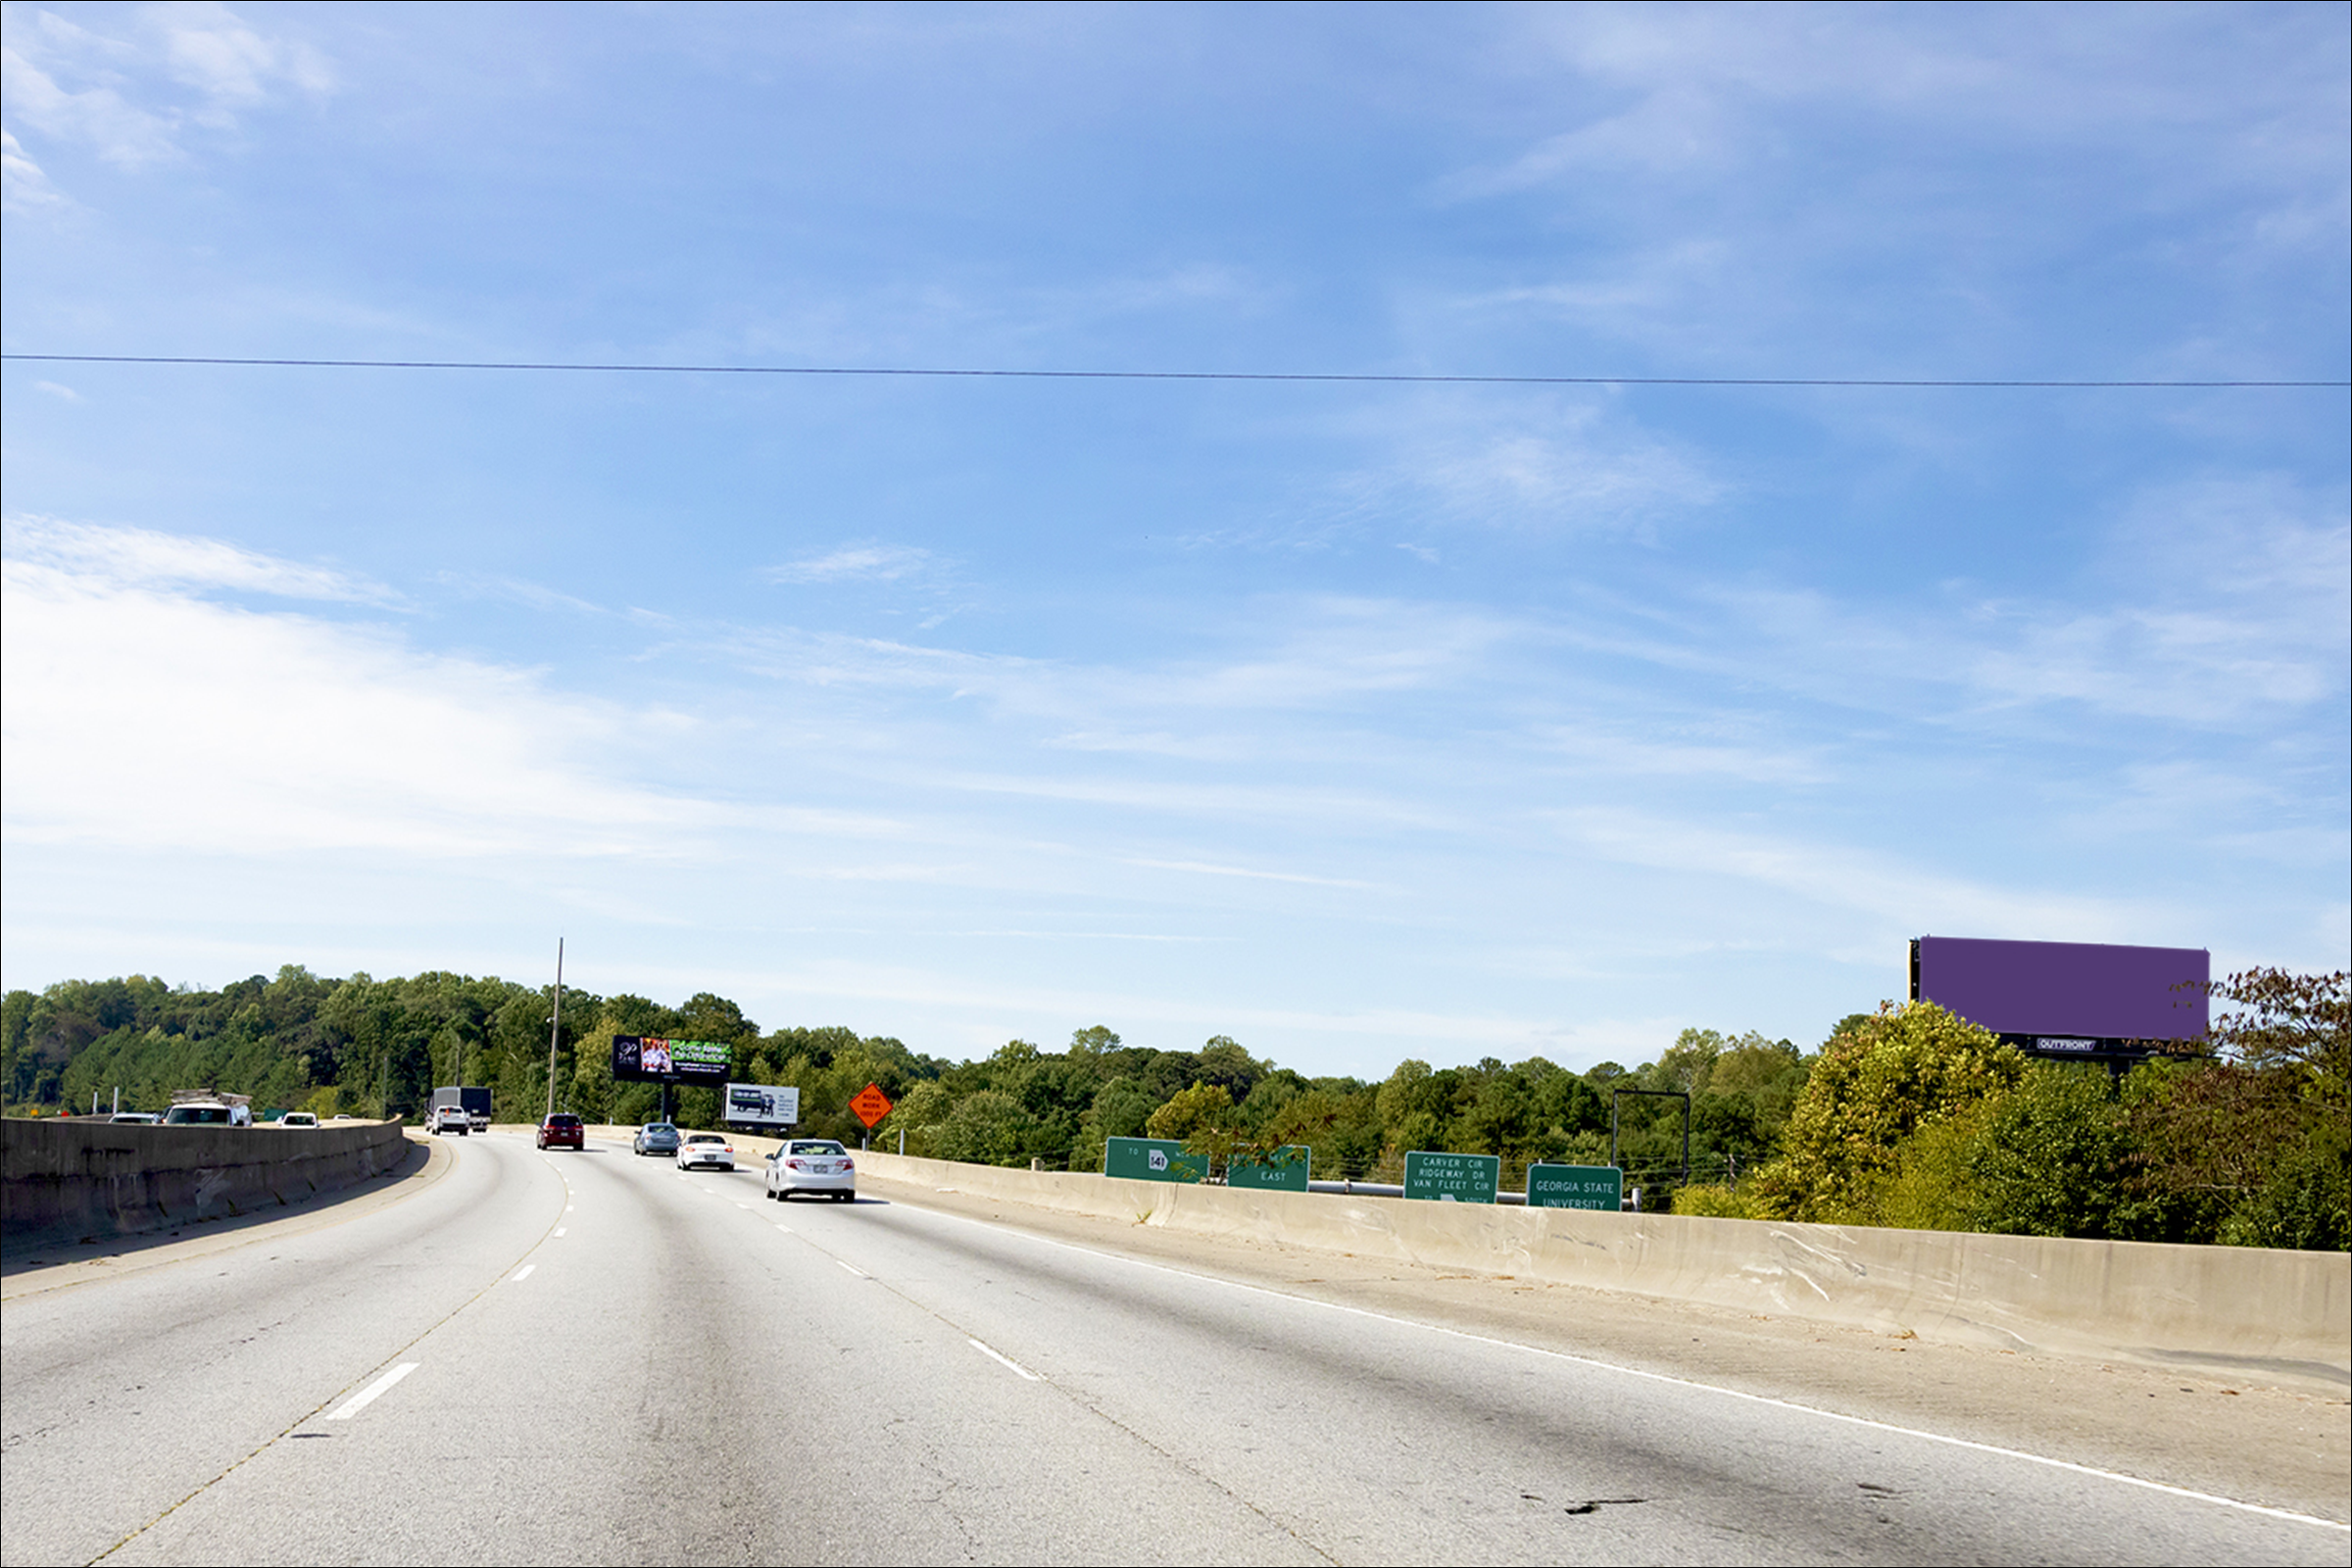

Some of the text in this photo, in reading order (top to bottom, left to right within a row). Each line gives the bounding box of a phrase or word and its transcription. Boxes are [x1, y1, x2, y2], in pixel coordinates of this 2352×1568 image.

[2039, 1039, 2093, 1050] OUTFRONT
[1151, 1156, 1165, 1167] 141
[1422, 1157, 1484, 1169] CARVER CIR
[1260, 1171, 1287, 1182] EAST
[1418, 1168, 1486, 1180] RIDGEWAY DR
[1413, 1179, 1490, 1191] VAN FLEET CIR
[1536, 1180, 1614, 1194] GEORGIA STATE
[1543, 1198, 1606, 1210] UNIVERSITY
